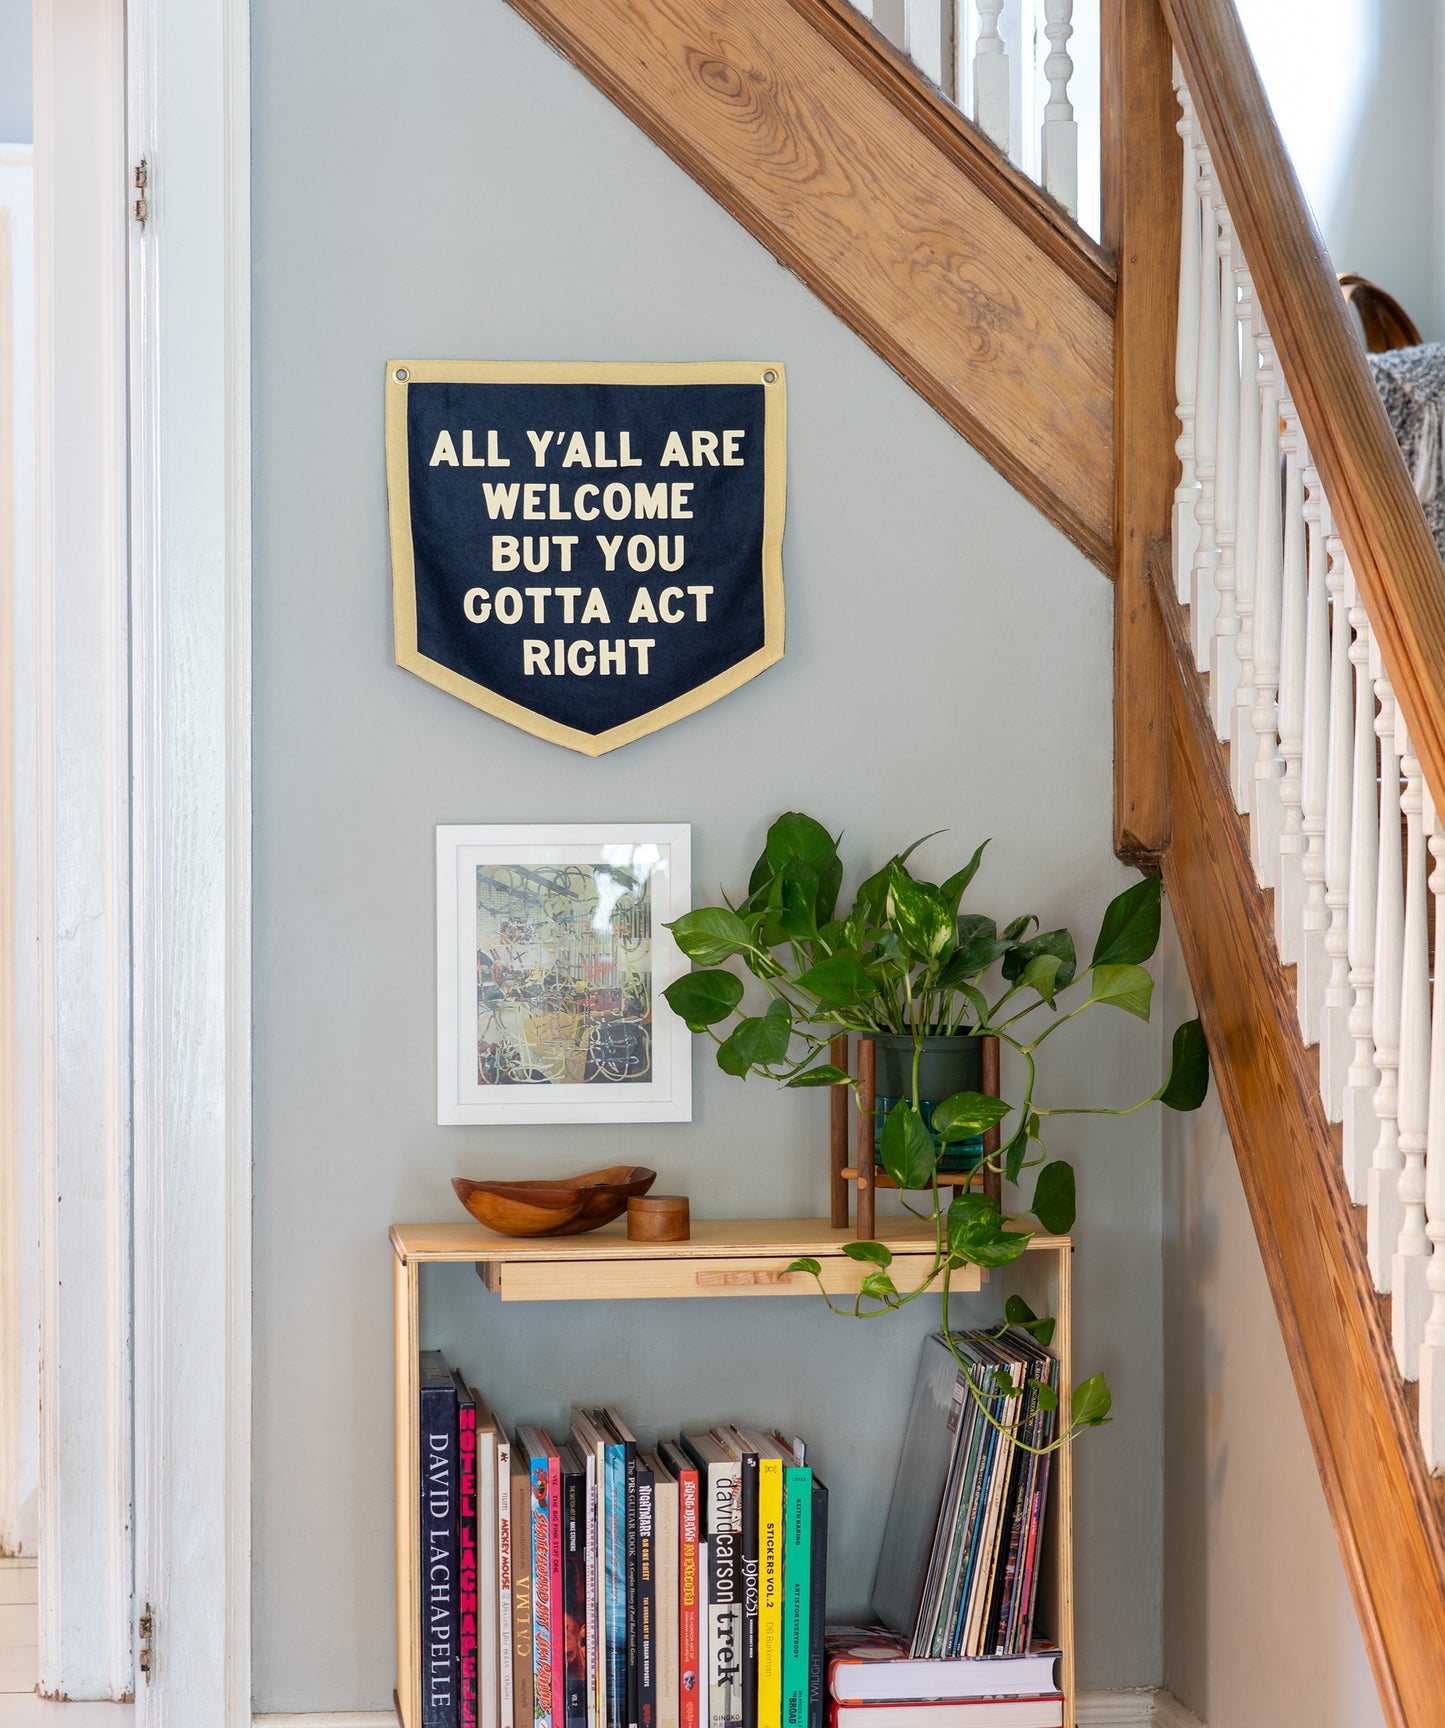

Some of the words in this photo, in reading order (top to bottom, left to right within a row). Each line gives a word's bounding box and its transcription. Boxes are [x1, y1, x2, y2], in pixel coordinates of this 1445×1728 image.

[429, 430, 511, 467] ALL
[526, 430, 643, 468] Y'ALL
[660, 430, 745, 467] ARE
[482, 482, 695, 521] WELCOME
[492, 535, 579, 572] BUT
[596, 535, 685, 572] YOU
[463, 587, 611, 625] GOTTA
[628, 586, 714, 624] ACT
[523, 638, 656, 676] RIGHT
[429, 1433, 449, 1519] DAVID
[460, 1408, 475, 1517] HOTEL
[610, 1487, 618, 1509] THE
[639, 1485, 652, 1537] NIGHTMARE
[501, 1518, 510, 1555] MICKEY
[642, 1538, 649, 1548] ON
[684, 1509, 696, 1543] DRAWN
[766, 1523, 775, 1575] STICKERS
[502, 1556, 510, 1590] MOUSE
[642, 1562, 650, 1581] SHEET
[683, 1557, 695, 1606] EXECUTED
[430, 1529, 450, 1707] LACHAPELLE
[461, 1527, 476, 1728] LACHAPELL
[535, 1602, 551, 1632] ART
[766, 1622, 773, 1634] DB
[717, 1611, 740, 1688] trek
[765, 1636, 774, 1677] Burkeman
[810, 1652, 822, 1704] TWILIGHT
[788, 1697, 797, 1725] BROAD
